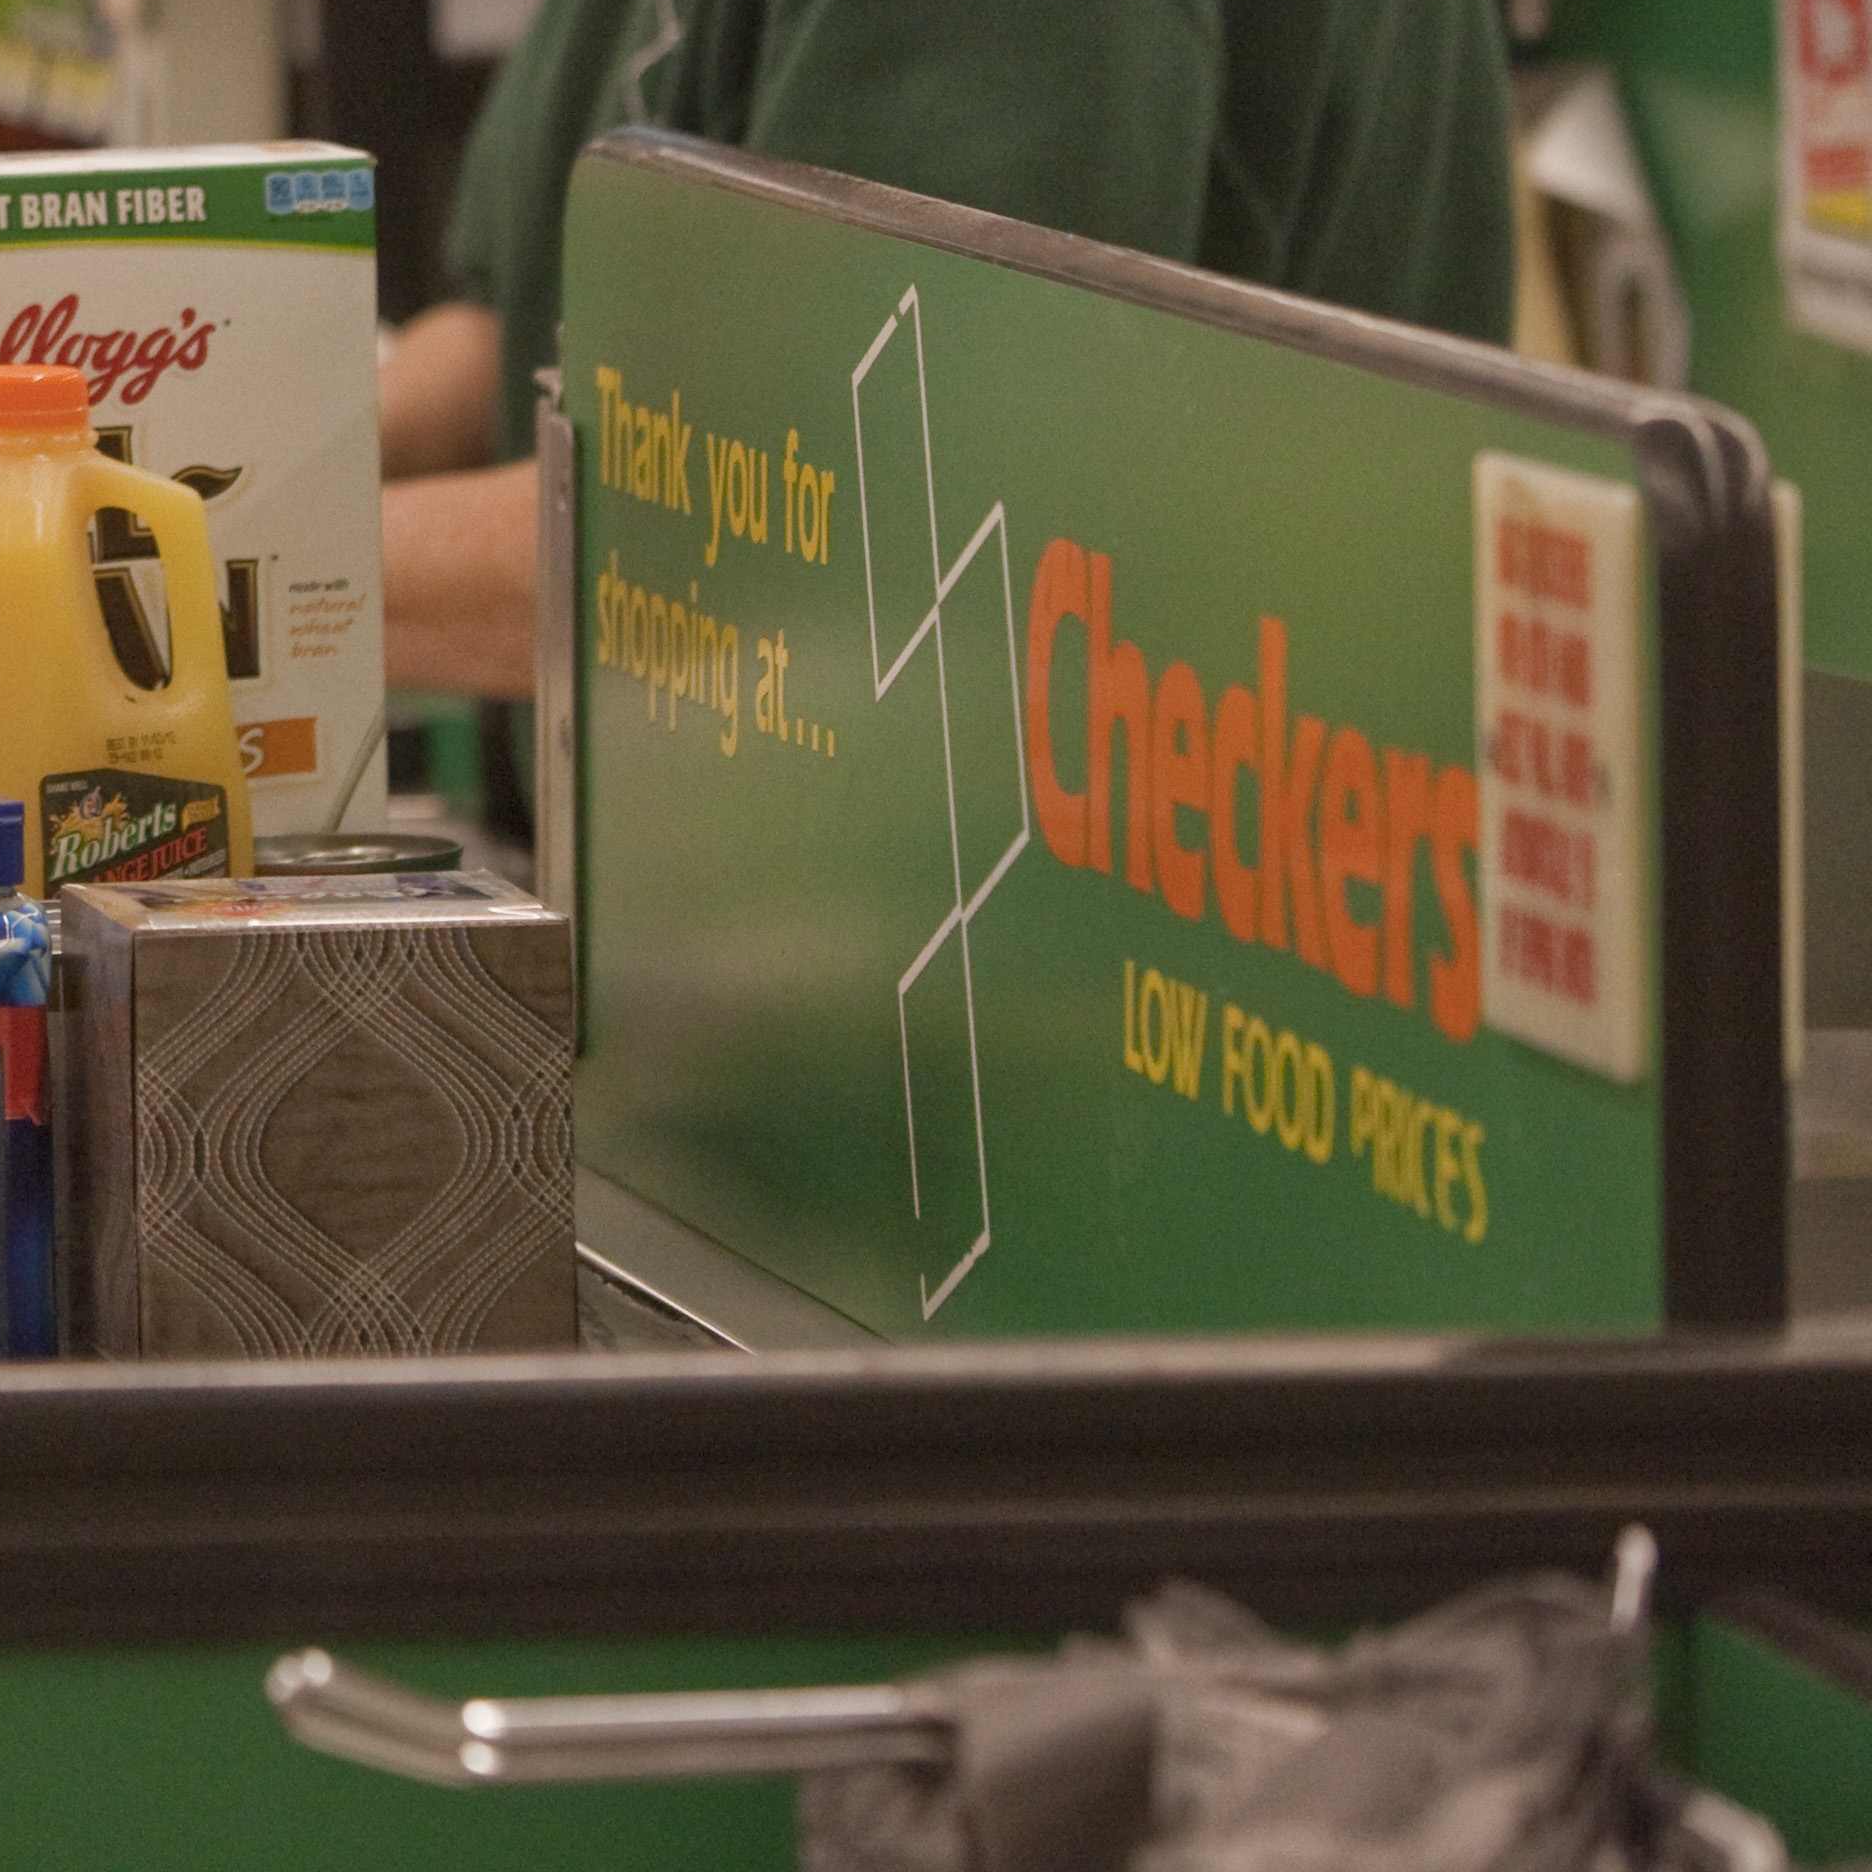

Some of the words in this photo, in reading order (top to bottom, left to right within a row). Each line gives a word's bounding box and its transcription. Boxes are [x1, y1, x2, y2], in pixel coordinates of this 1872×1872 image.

[21, 190, 108, 230] BRAN
[116, 184, 207, 225] FIBER
[594, 364, 691, 515] Thank
[704, 431, 770, 566] you
[781, 426, 836, 565] for
[594, 556, 741, 760] shopping
[49, 800, 181, 881] Roberts
[149, 826, 209, 878] JUICE
[1025, 536, 1483, 1043] Checkers
[1124, 957, 1207, 1104] LOW
[1222, 1006, 1337, 1166] FOOD
[1350, 1062, 1488, 1244] PRICES
